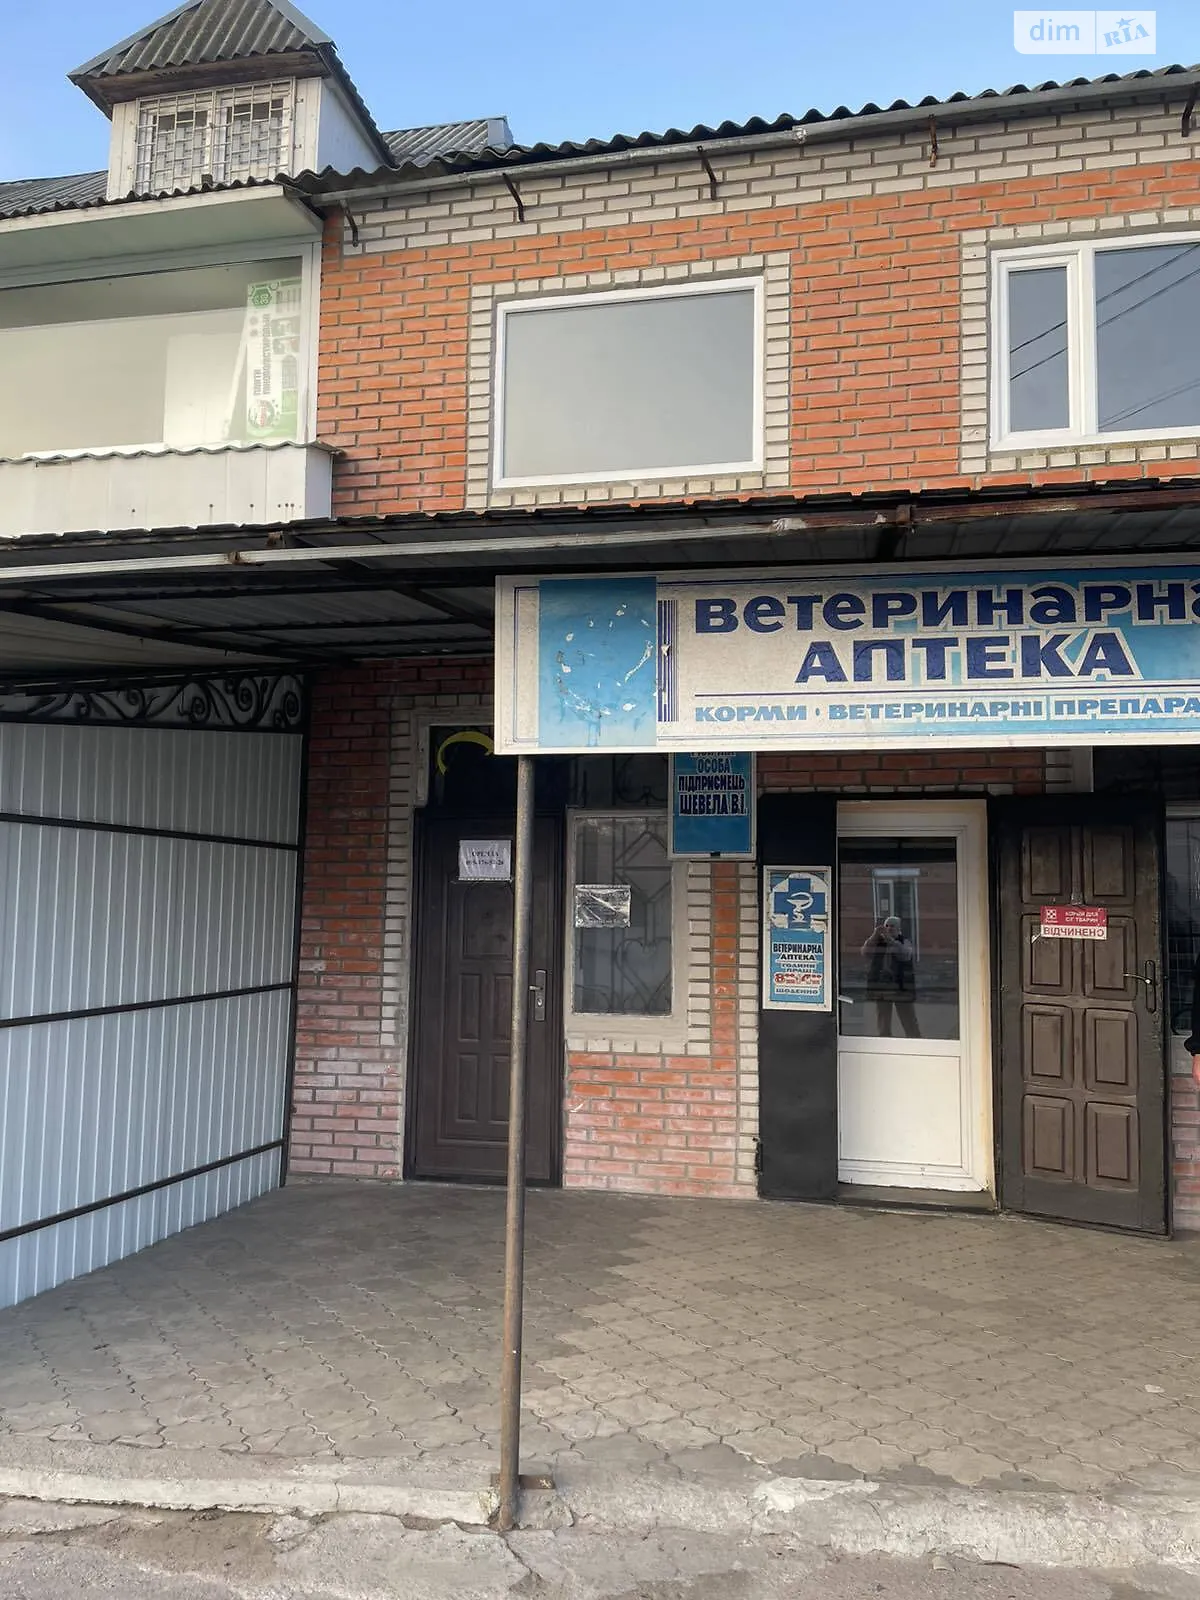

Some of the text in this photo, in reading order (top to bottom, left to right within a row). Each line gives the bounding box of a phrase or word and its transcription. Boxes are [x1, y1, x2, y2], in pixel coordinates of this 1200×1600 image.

[795, 631, 1135, 684] АПТЕКА
[695, 704, 807, 722] КОРМИ
[828, 700, 1043, 720] ВЕТЕРИНАРНІ
[697, 758, 731, 773] ОСОБА
[678, 775, 746, 792] ПІДПРИЄМЕЦЬ
[679, 793, 729, 815] ШЕВЕЛА
[1043, 926, 1105, 937] ВІДЧИНЕНО
[773, 943, 823, 954] ВЕТЕРИНАРНА
